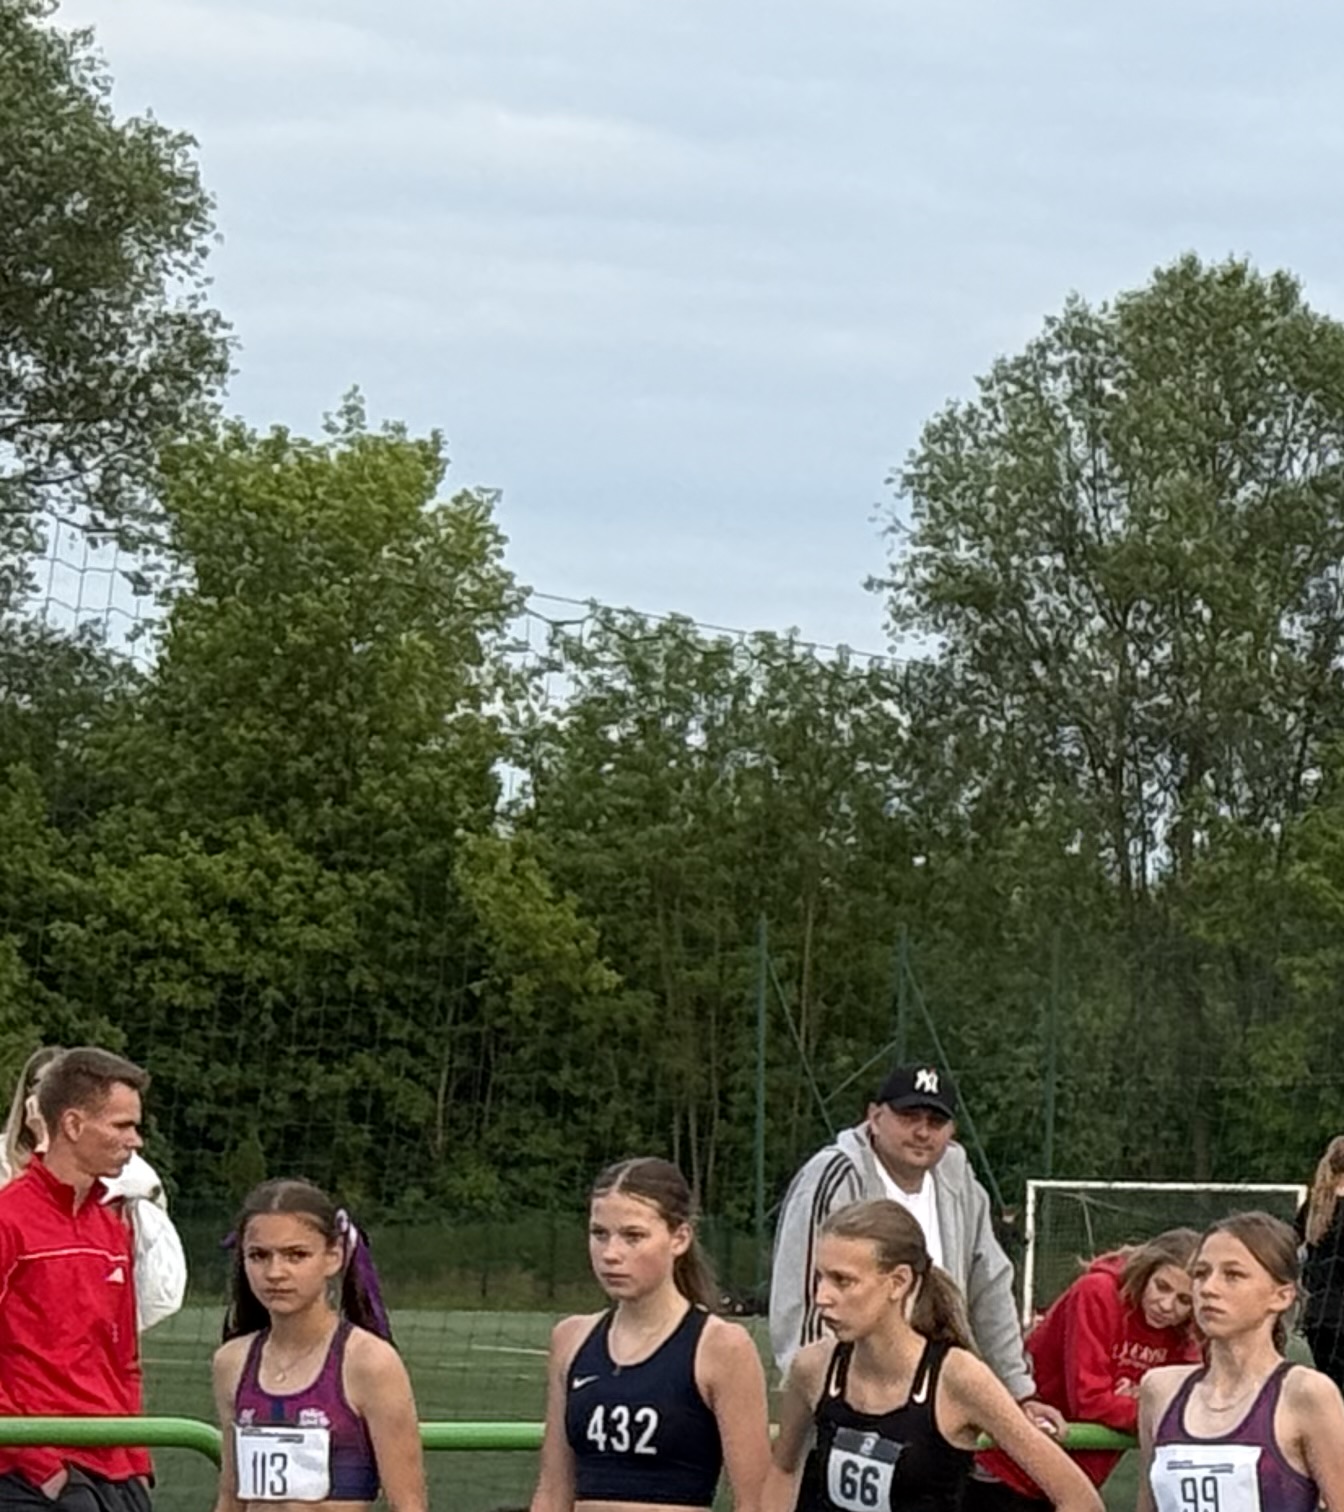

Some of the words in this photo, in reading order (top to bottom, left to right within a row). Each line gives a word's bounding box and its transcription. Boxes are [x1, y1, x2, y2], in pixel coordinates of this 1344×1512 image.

[586, 1405, 660, 1455] 432
[252, 1451, 288, 1496] 113
[840, 1459, 880, 1507] 66
